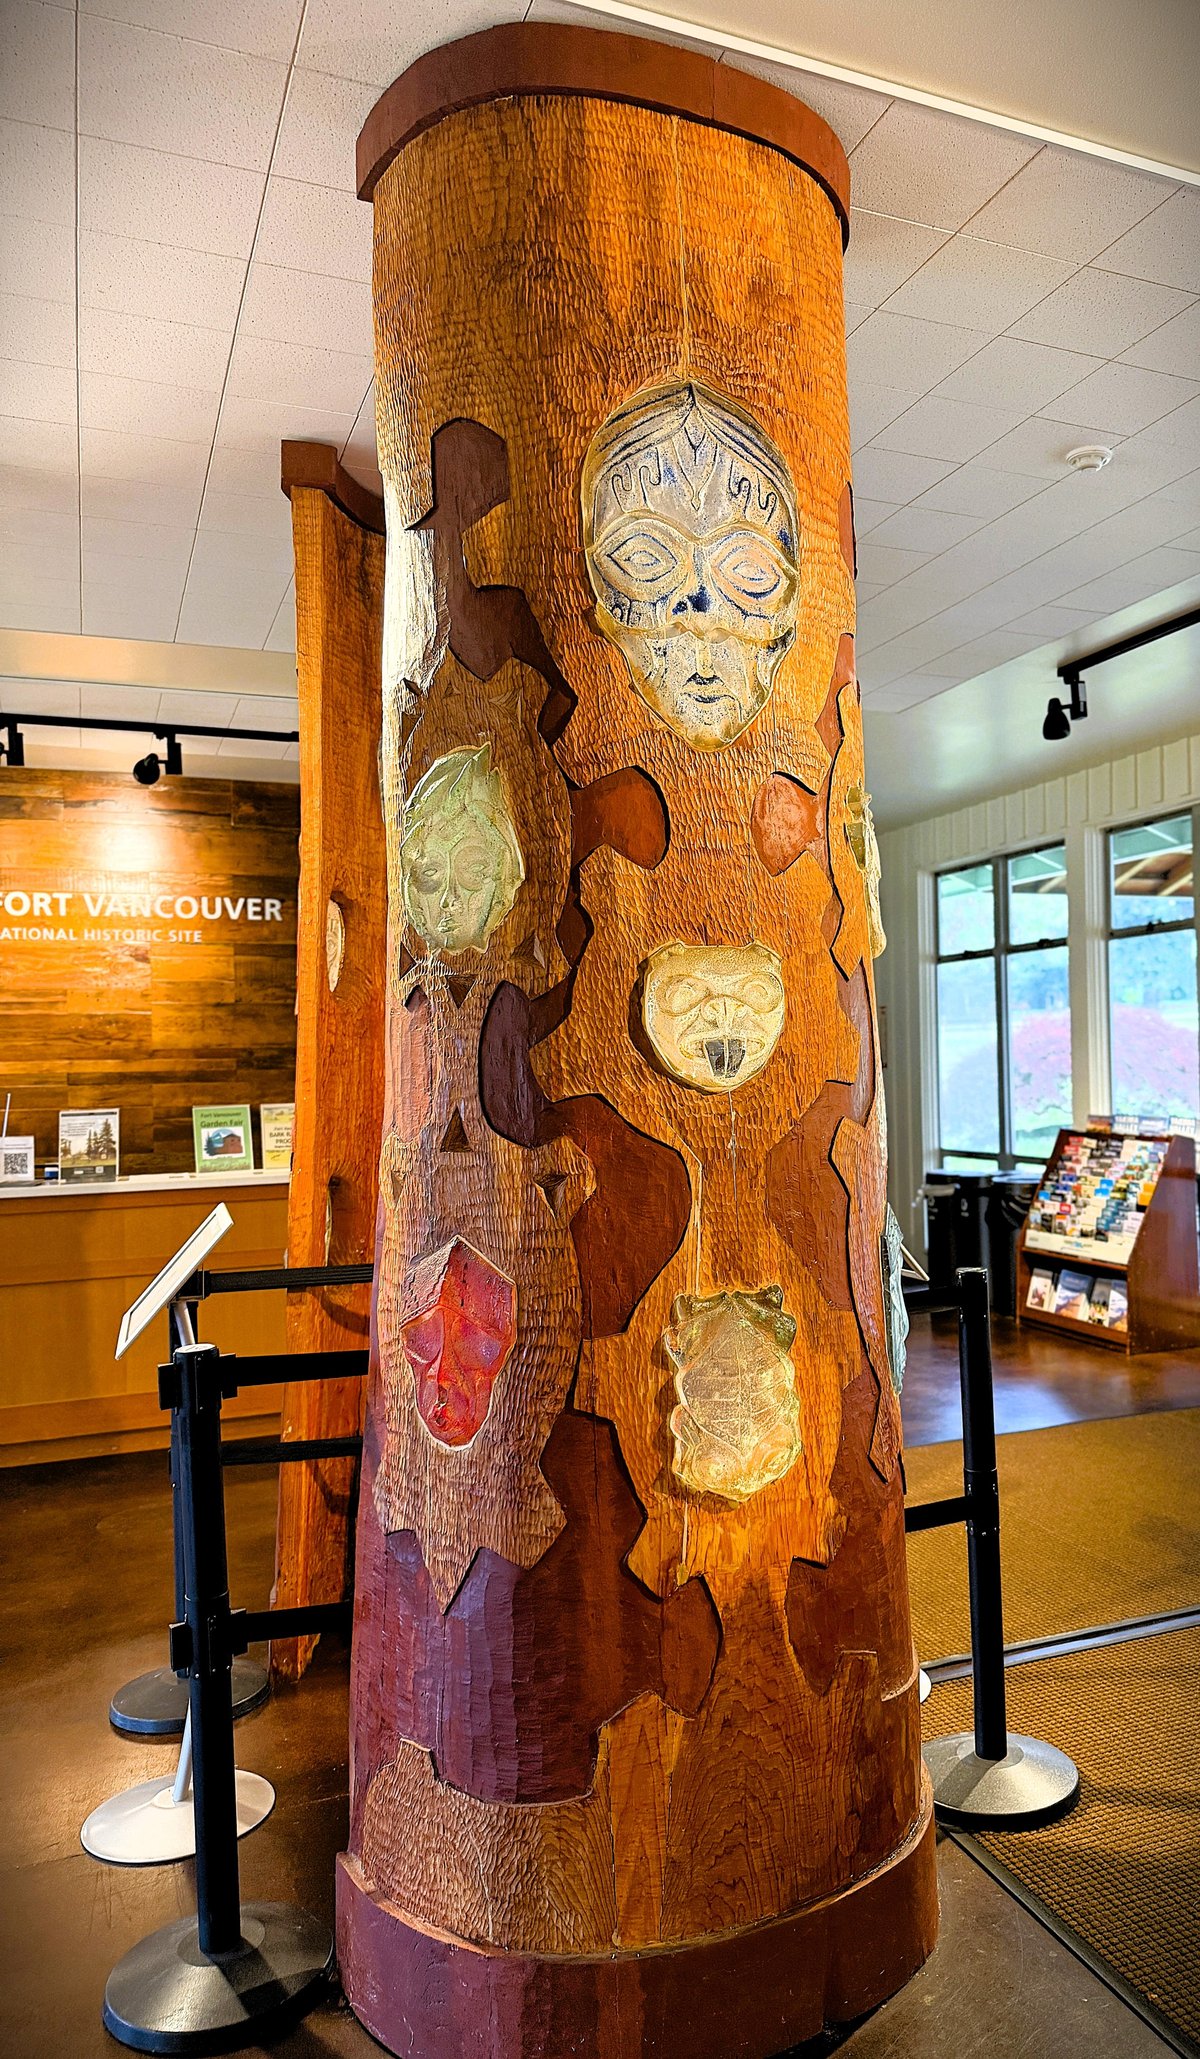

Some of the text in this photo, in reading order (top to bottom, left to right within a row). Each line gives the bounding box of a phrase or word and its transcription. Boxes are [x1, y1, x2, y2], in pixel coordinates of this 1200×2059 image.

[0, 891, 283, 921] ORT VANCOUVER
[84, 928, 163, 942] HISTORIC
[168, 929, 203, 943] SITE
[200, 1119, 243, 1128] Garden Fair
